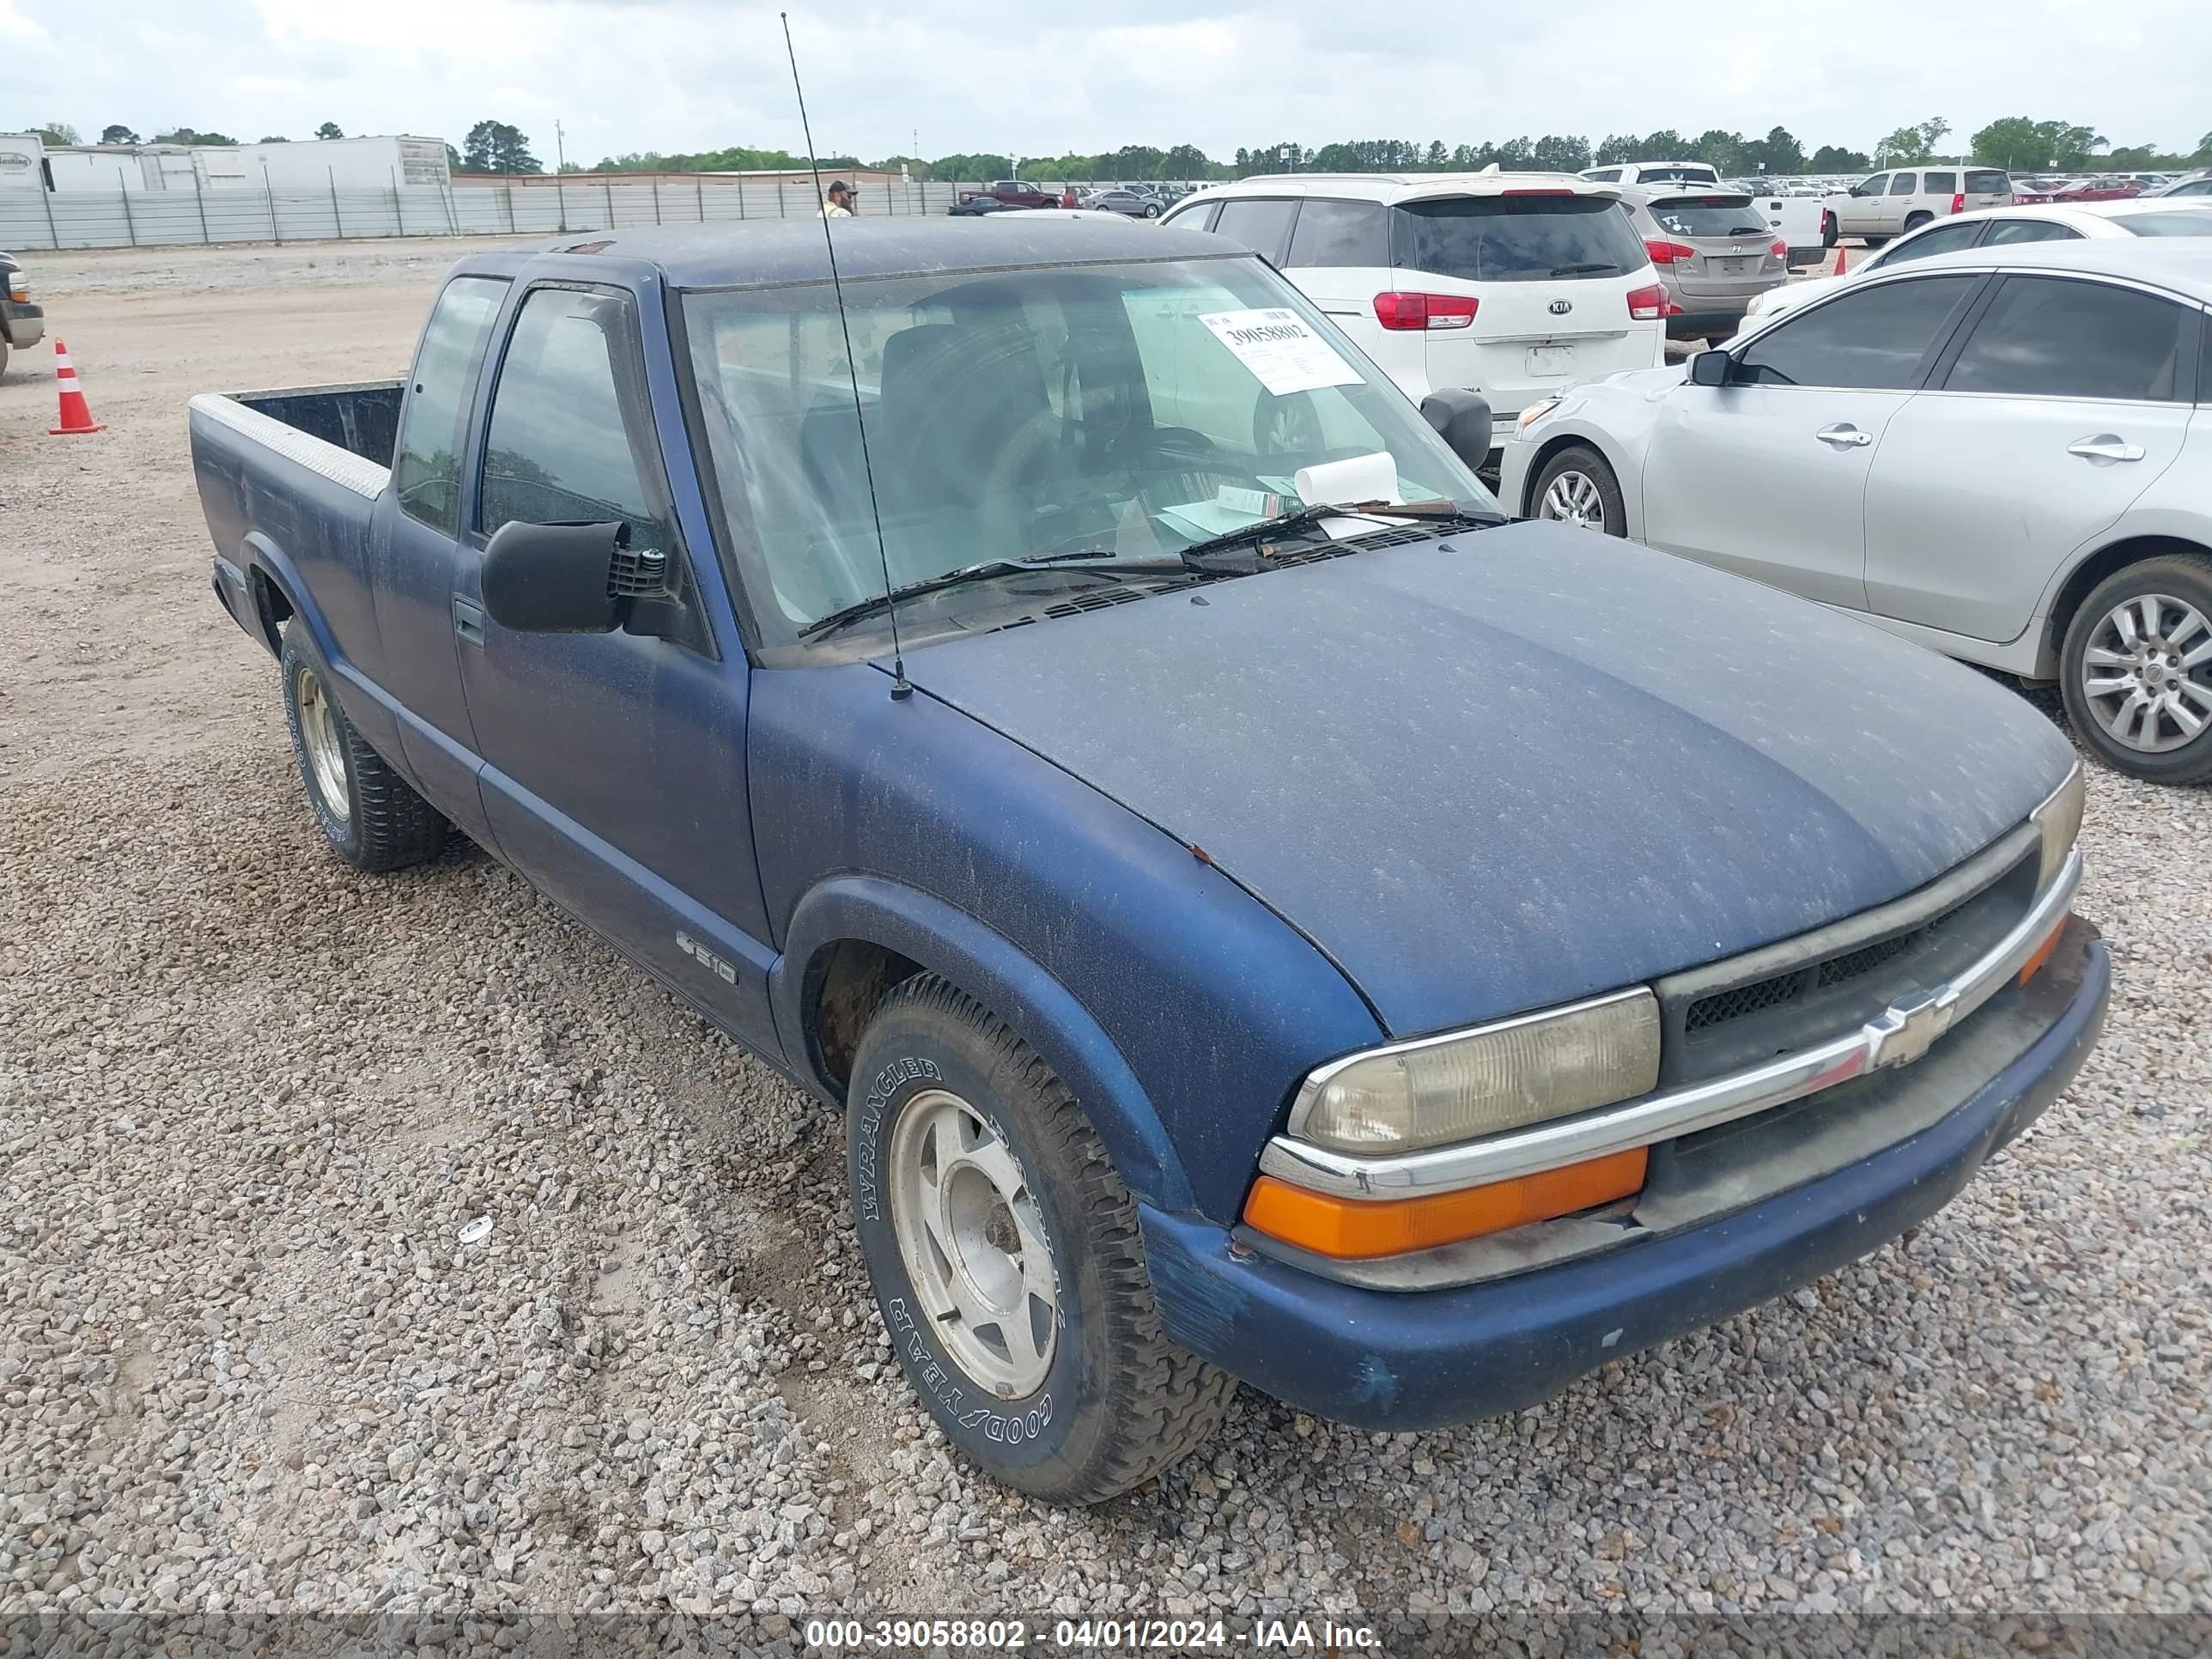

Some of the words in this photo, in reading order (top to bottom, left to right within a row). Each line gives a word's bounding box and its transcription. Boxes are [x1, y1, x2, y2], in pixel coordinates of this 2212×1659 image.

[1226, 324, 1309, 346] 39058802
[1552, 301, 1571, 313] KIA
[859, 1057, 943, 1220] WRANGLER
[890, 1297, 1052, 1444] GOODYEAR
